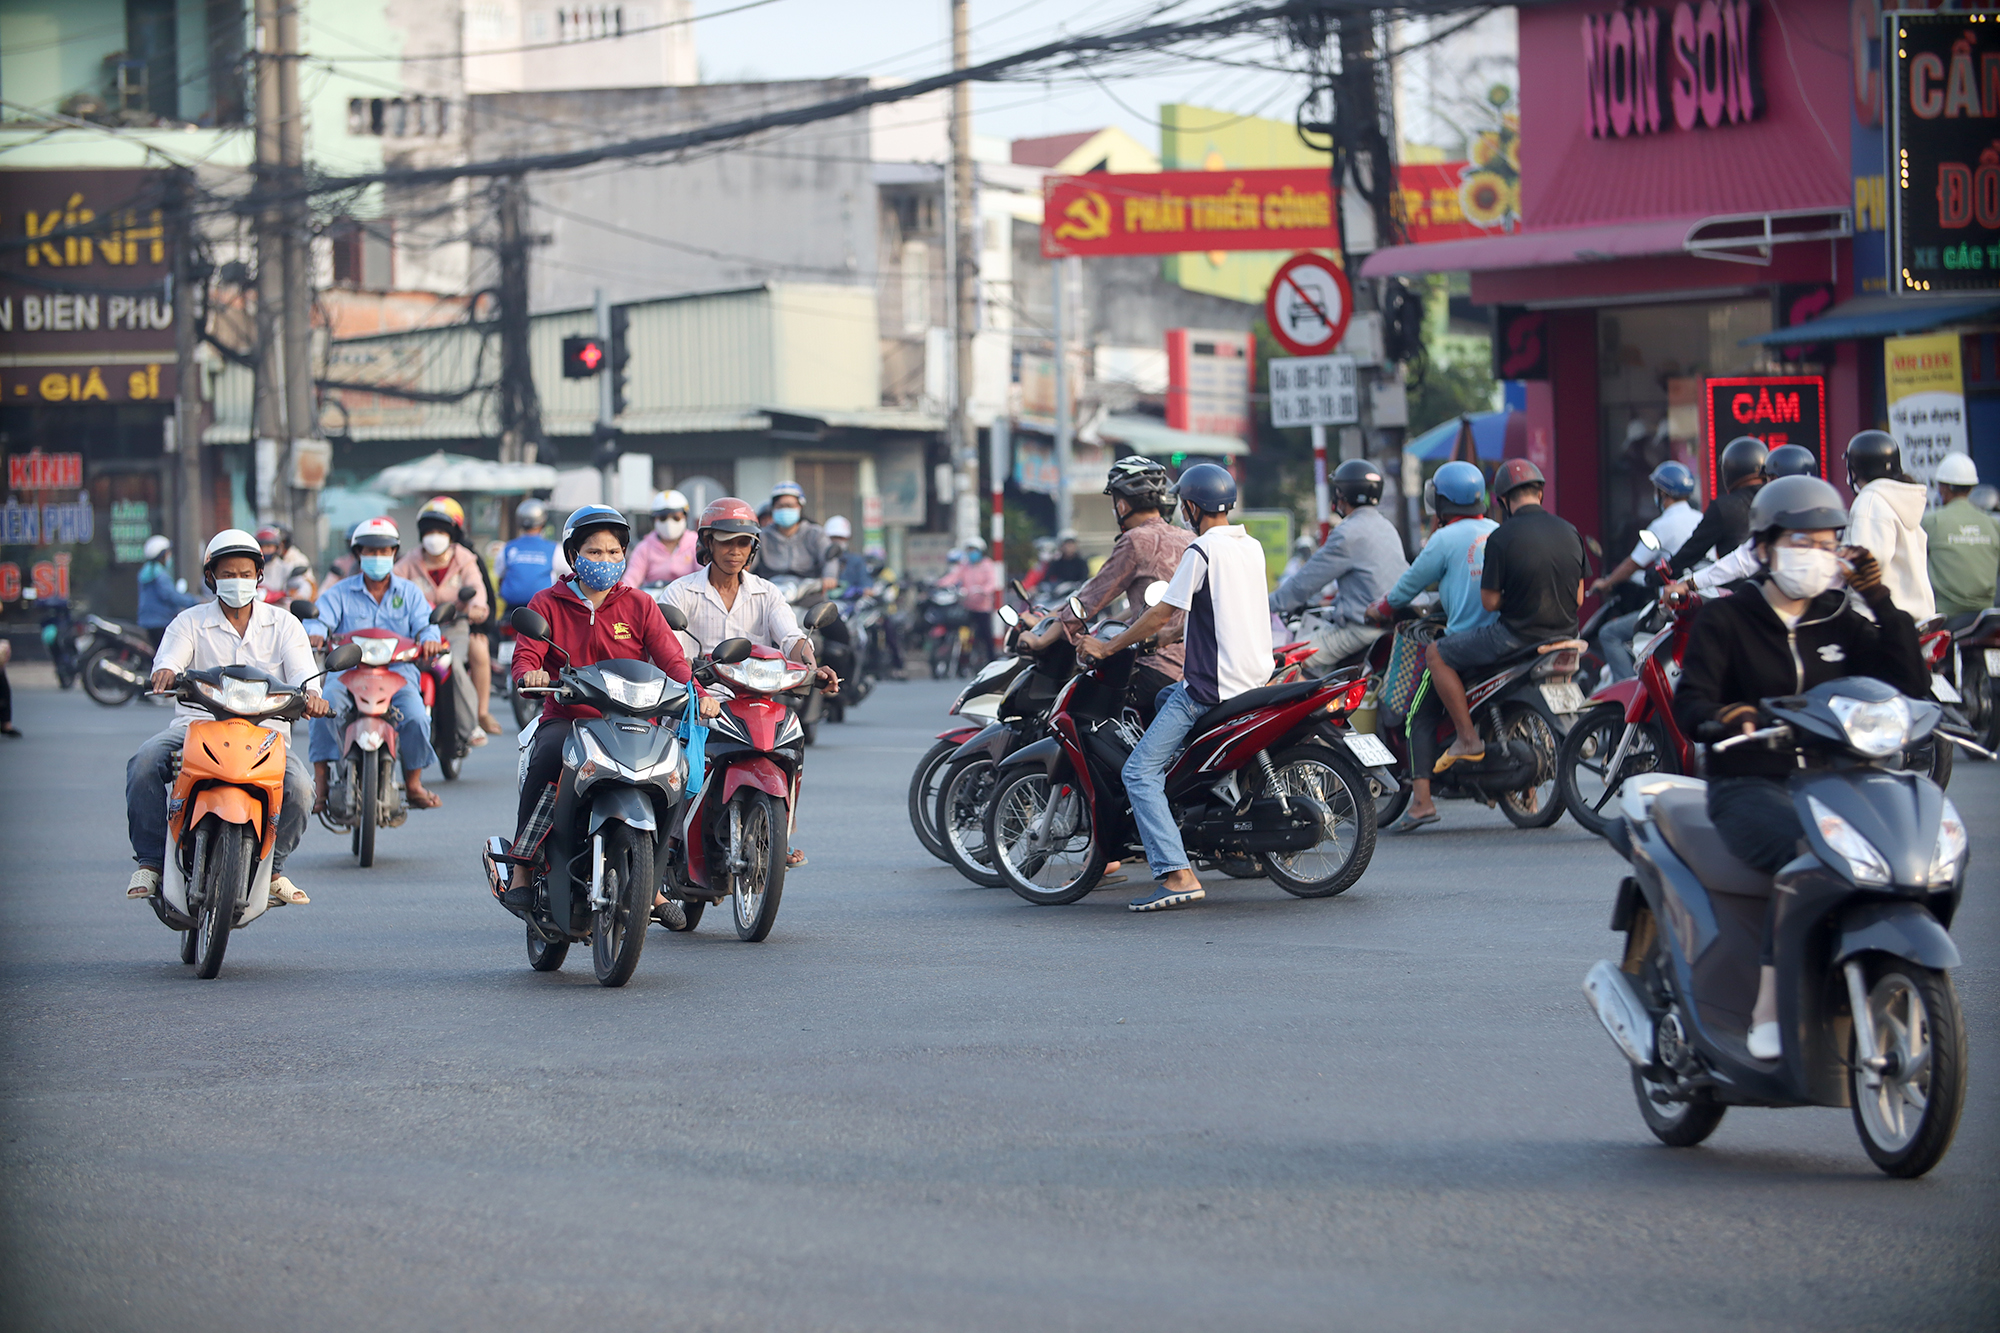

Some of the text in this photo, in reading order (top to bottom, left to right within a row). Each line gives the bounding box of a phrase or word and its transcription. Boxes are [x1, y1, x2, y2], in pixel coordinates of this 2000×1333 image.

[25, 192, 164, 267] KÍNH
[8, 446, 83, 490] KÍNH
[228, 720, 250, 728] HONDA
